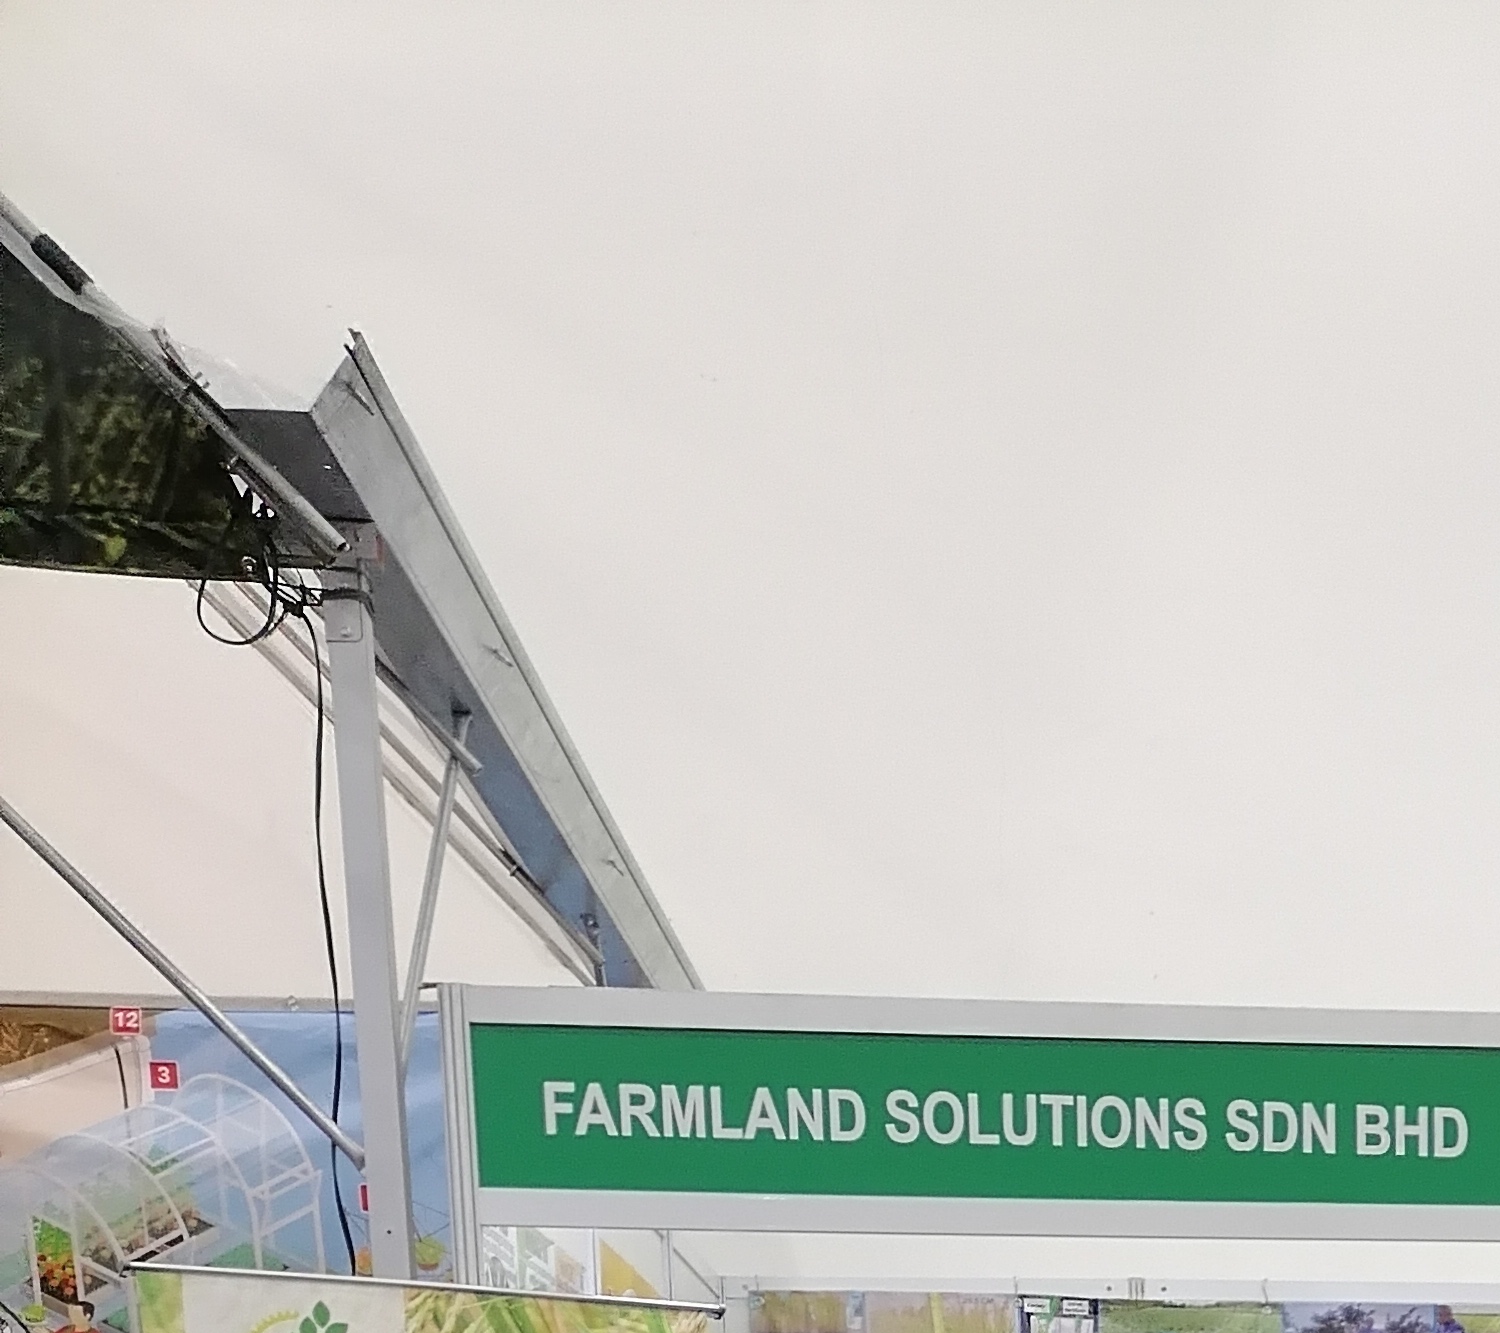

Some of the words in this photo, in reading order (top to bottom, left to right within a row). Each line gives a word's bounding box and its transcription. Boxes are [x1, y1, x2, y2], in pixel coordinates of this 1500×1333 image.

[113, 1010, 139, 1028] 12
[157, 1066, 171, 1084] 3
[542, 1081, 867, 1142] FARMLAND
[885, 1090, 1208, 1150] SOLUTIONS
[1225, 1099, 1336, 1154] SDN
[1355, 1104, 1468, 1158] BHD
